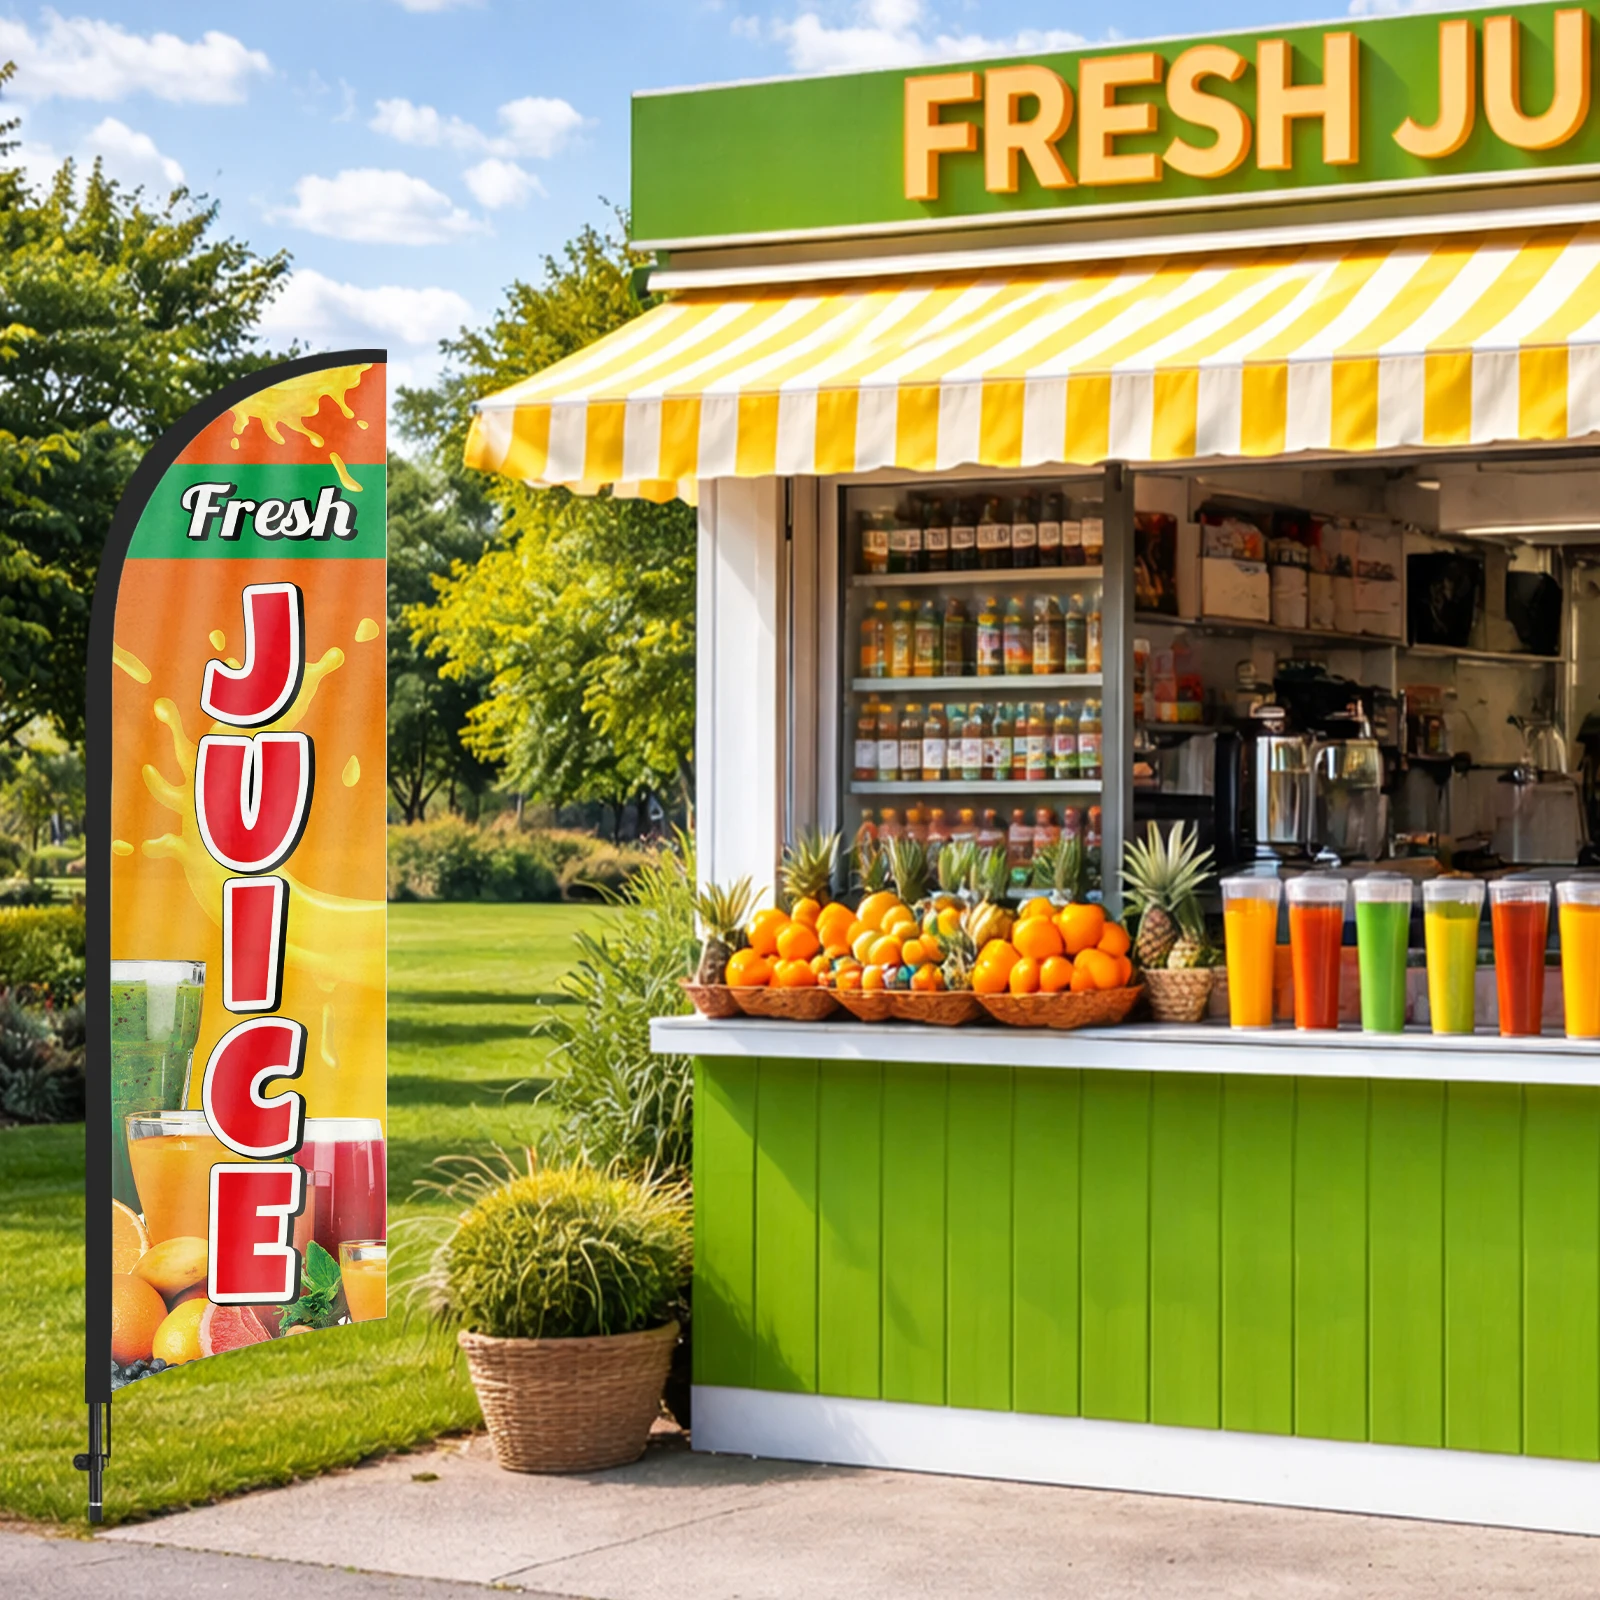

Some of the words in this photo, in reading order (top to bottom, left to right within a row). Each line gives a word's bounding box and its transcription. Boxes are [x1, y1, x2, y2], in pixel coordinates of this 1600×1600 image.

[904, 31, 1360, 200] FRESH
[1392, 8, 1591, 159] JU
[181, 481, 358, 541] Fresh
[194, 582, 316, 1306] JUICE
